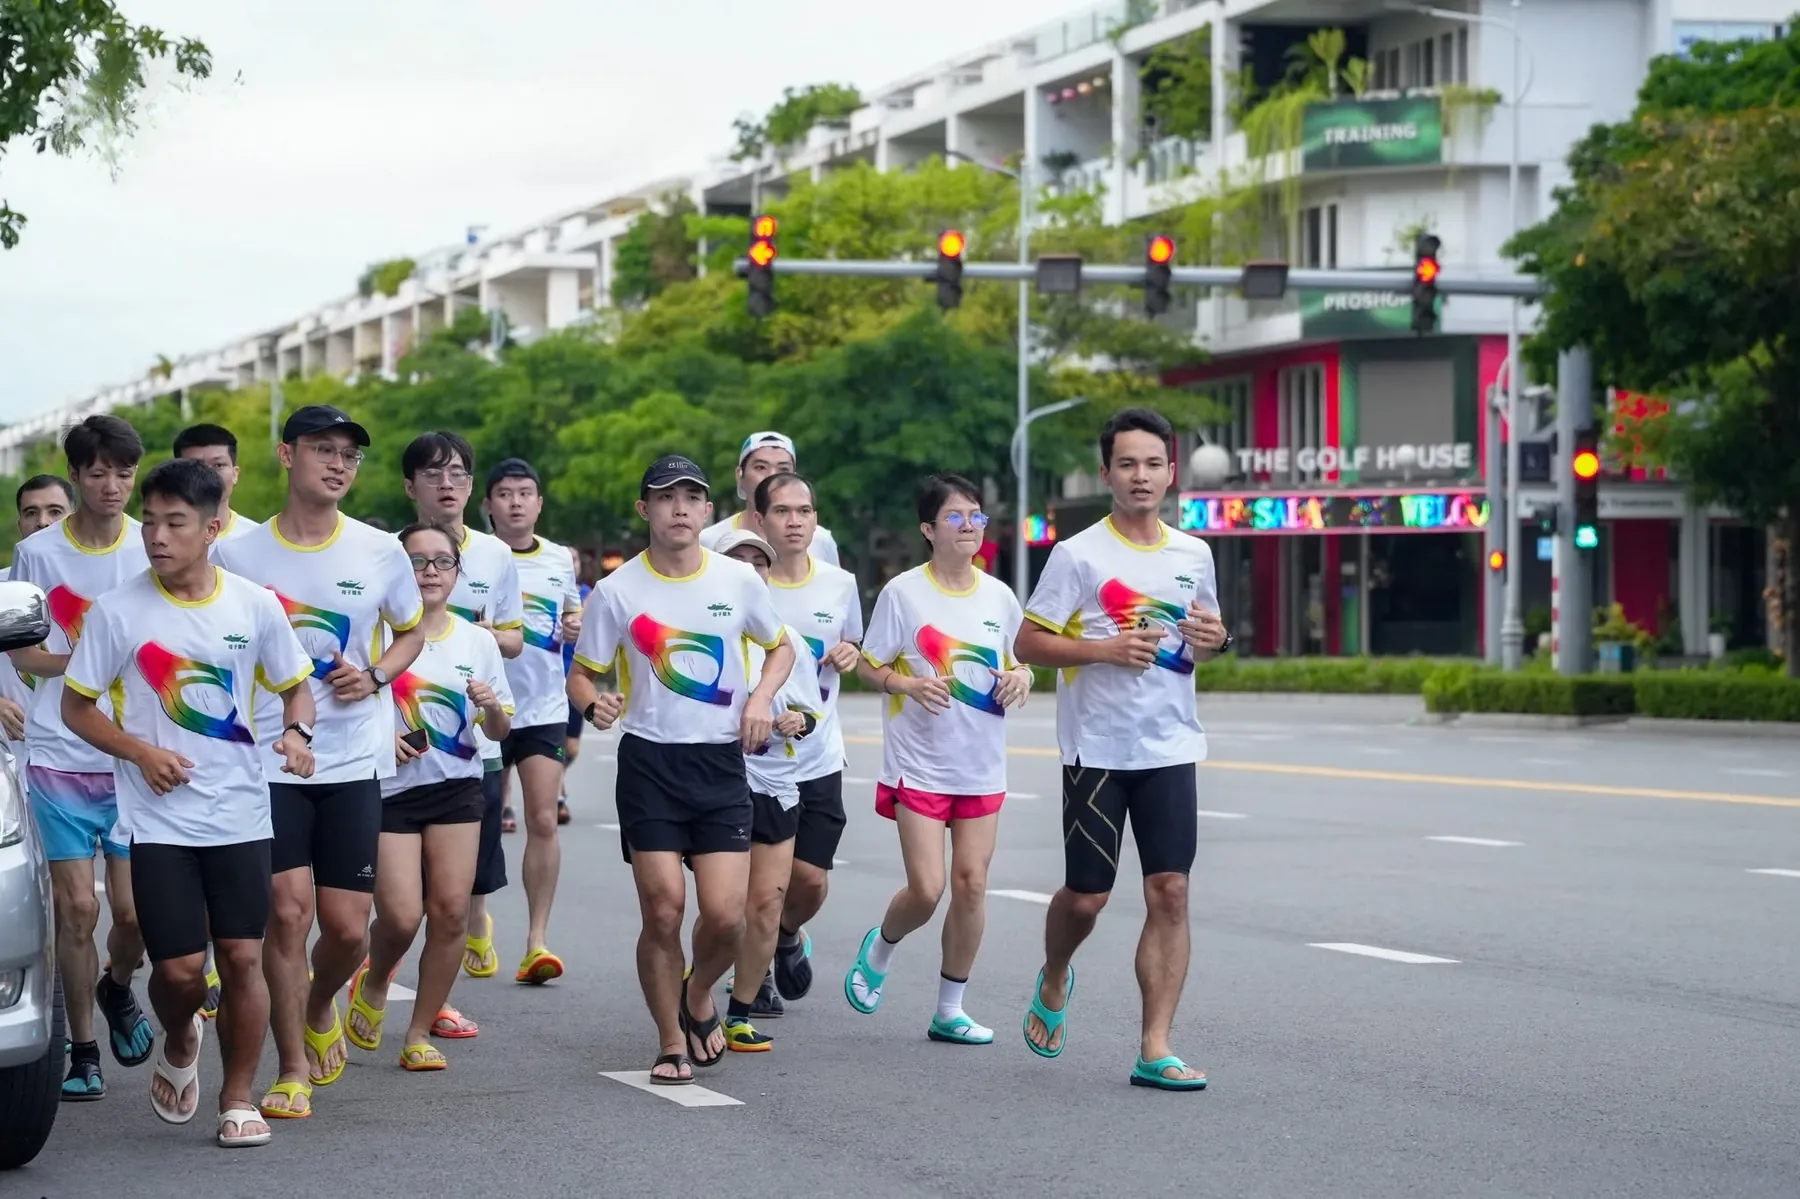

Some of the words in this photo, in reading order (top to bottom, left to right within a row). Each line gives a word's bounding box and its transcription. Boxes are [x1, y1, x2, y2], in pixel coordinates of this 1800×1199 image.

[1324, 122, 1417, 144] TRAINING
[1237, 447, 1290, 473] THE
[1296, 445, 1371, 472] GOLF
[1376, 442, 1472, 471] HOUSE
